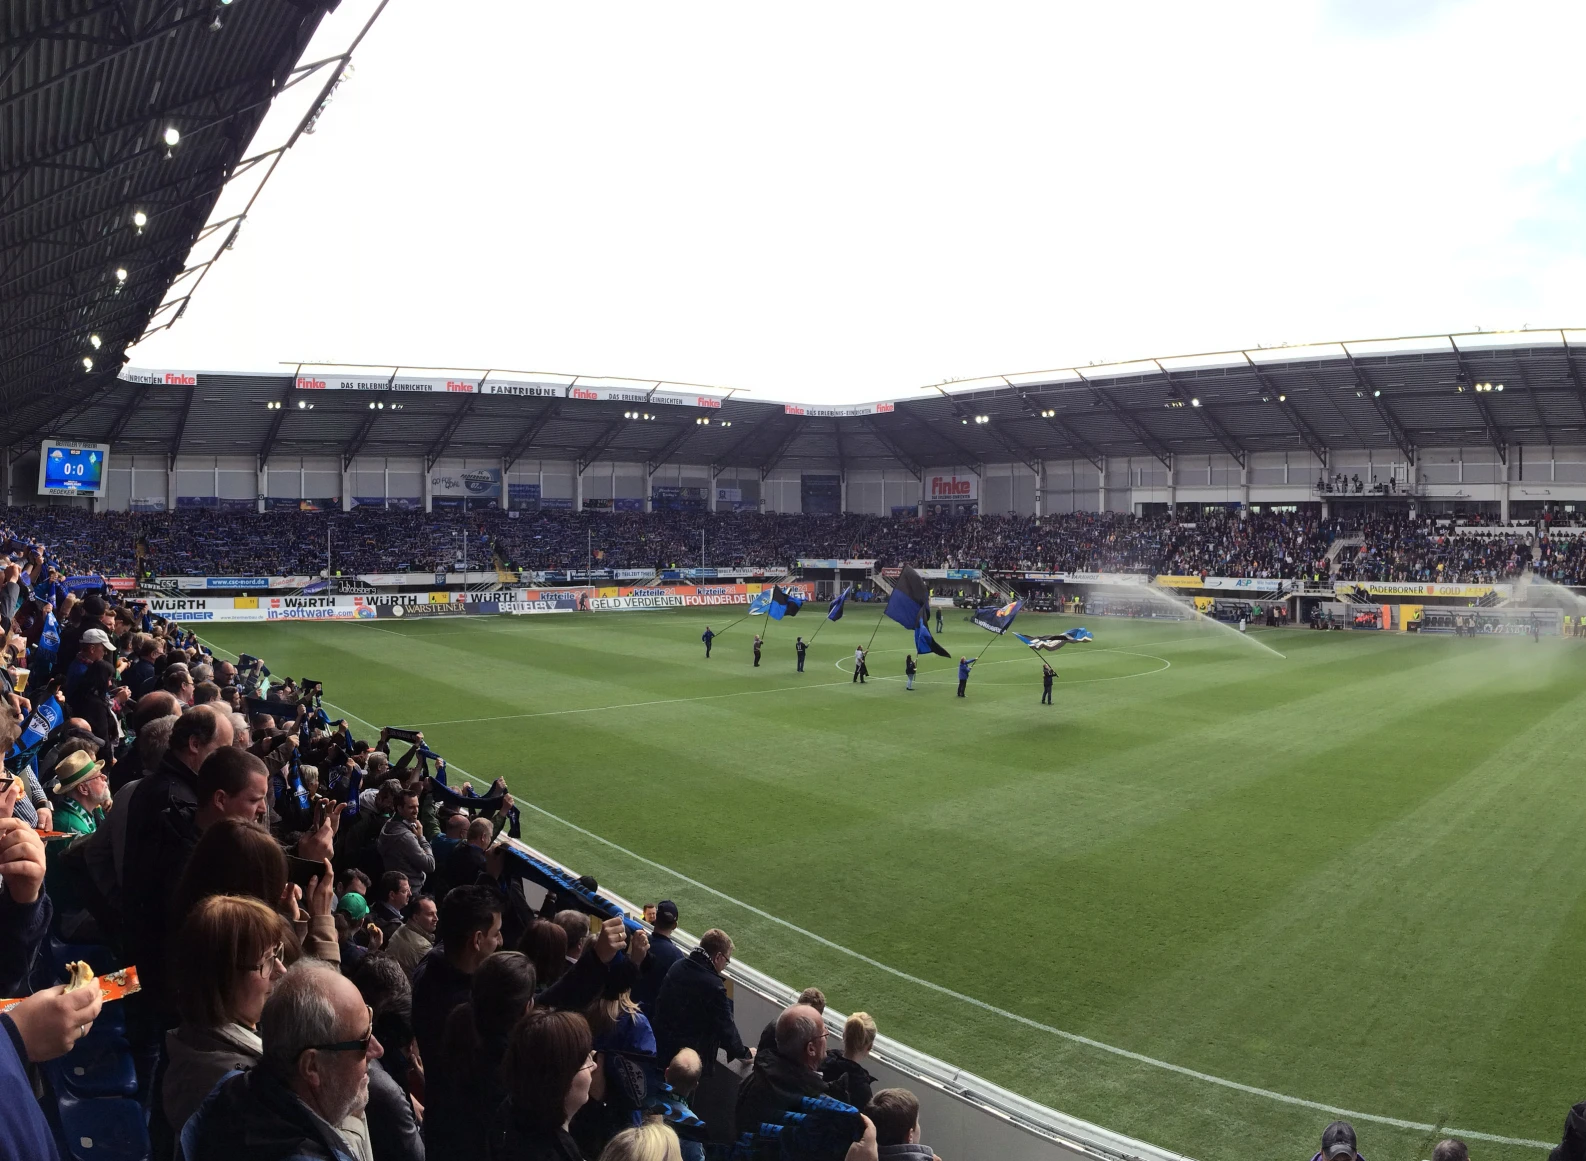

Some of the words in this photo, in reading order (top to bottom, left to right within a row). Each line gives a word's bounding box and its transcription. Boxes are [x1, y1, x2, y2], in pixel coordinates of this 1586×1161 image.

[165, 373, 196, 386] finke
[297, 378, 326, 390] finke
[341, 382, 354, 390] DAS
[446, 381, 474, 393] finke
[573, 388, 598, 400] finke
[698, 397, 721, 408] finke
[785, 405, 804, 415] finke
[876, 403, 894, 413] finke
[64, 463, 84, 476] 0:0
[49, 488, 75, 496] REDEKER
[932, 477, 971, 496] finke
[161, 580, 177, 588] CSC
[1369, 584, 1424, 595] PADERBORNER
[1439, 586, 1461, 595] GOLD
[285, 597, 336, 608] WÜRTH
[366, 595, 418, 606] WÜRTH
[471, 592, 518, 603] WÜRTH
[591, 598, 621, 609] GELD
[625, 595, 683, 607] VERDIENEN
[686, 593, 747, 605] FOUNDER.DE
[151, 599, 206, 610] WÜRTH
[405, 602, 466, 614] WARSTEINER
